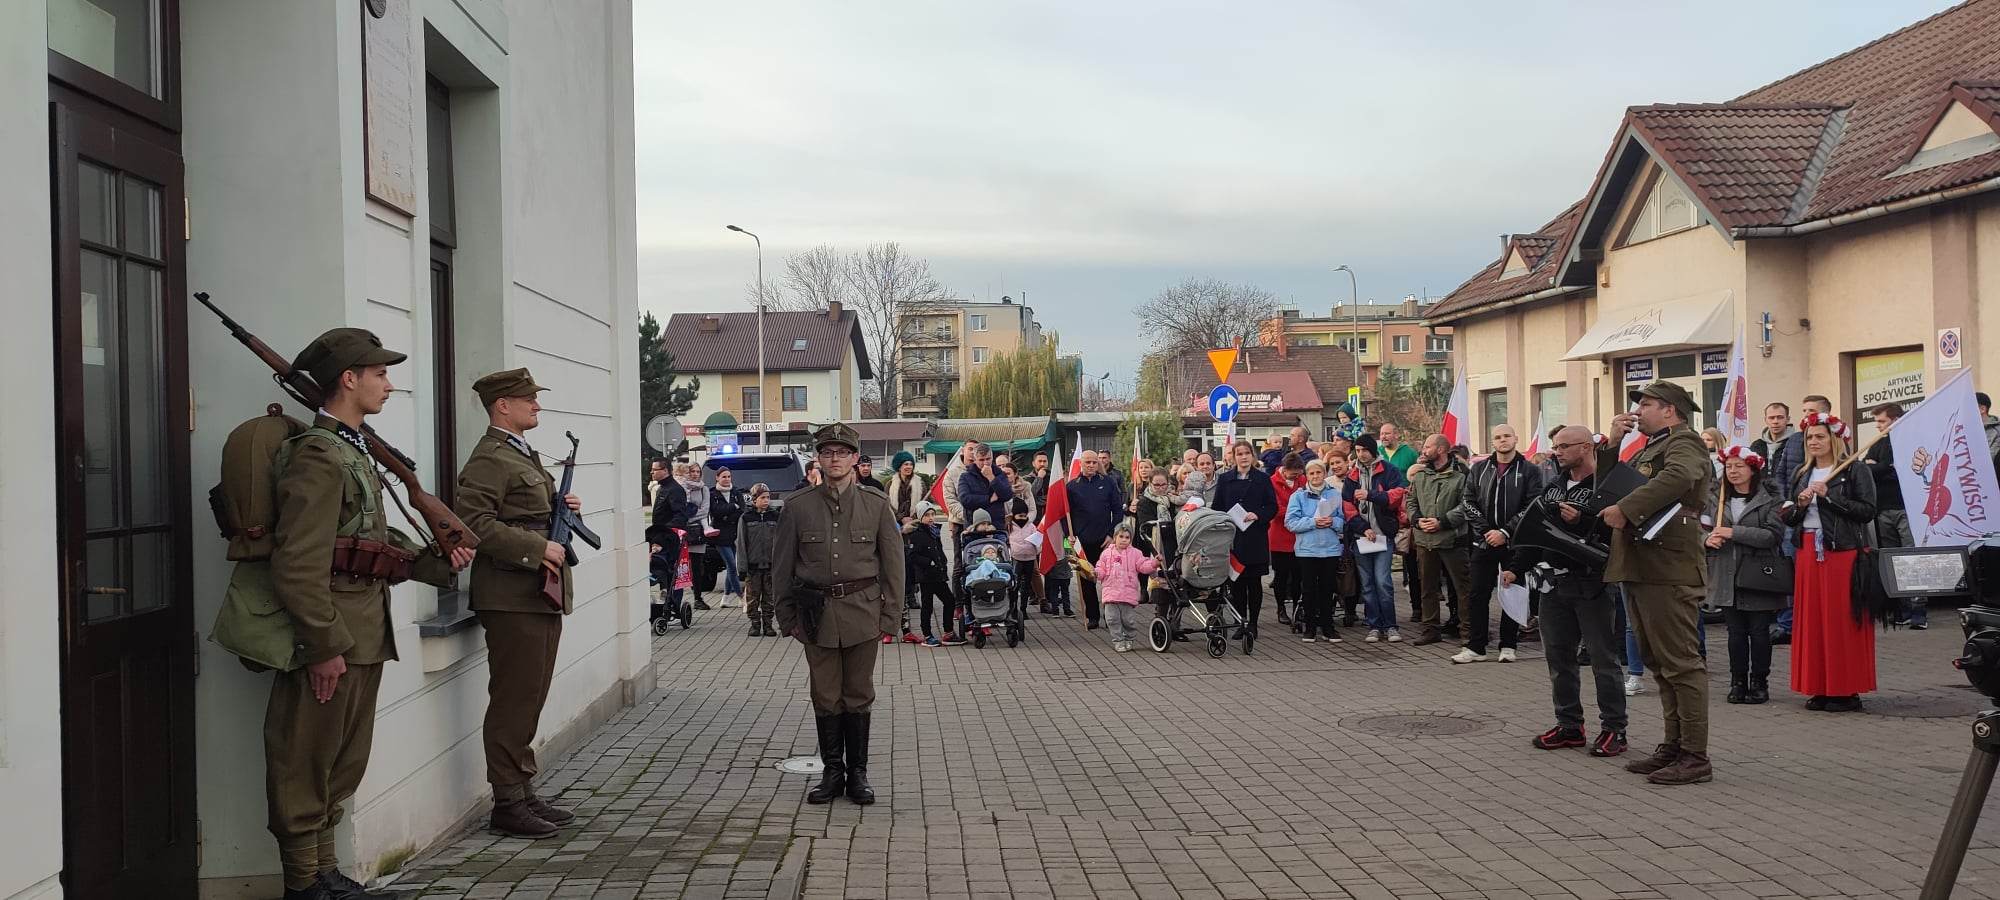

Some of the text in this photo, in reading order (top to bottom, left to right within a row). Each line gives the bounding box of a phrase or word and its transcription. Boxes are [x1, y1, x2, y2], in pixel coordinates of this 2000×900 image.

[1888, 373, 1922, 387] ARTYKUŁY
[1863, 383, 1923, 404] SPOŻYWCZE
[1954, 424, 1988, 523] AKTYWIŚCI
